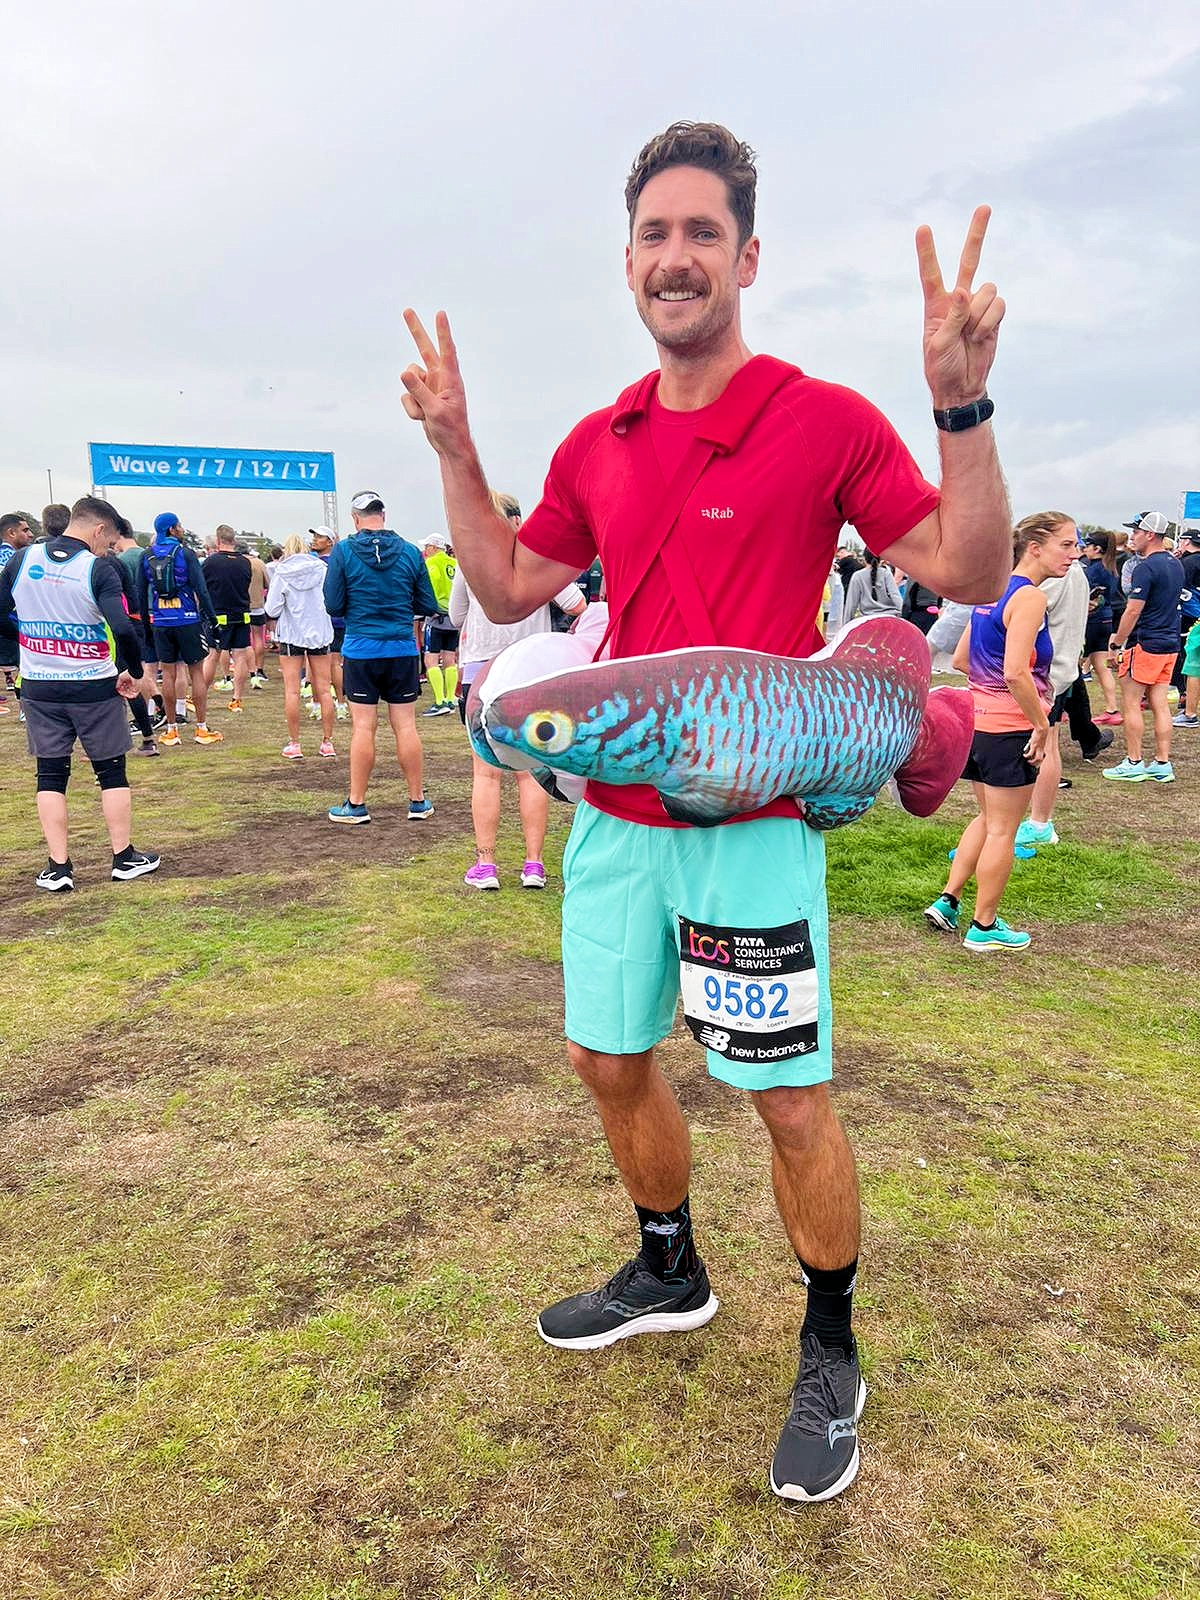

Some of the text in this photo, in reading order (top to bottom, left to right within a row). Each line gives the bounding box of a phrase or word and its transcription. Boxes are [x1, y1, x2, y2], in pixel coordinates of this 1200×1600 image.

[109, 455, 320, 479] Wave 2 / 7 / 12 / 17
[711, 507, 734, 519] Rab
[58, 642, 101, 658] LIVES
[688, 926, 731, 965] tcs
[733, 936, 765, 947] TATA
[734, 942, 805, 959] CONSULTANCY
[735, 958, 782, 969] SERVICES
[704, 975, 789, 1020] 9582
[731, 1046, 754, 1058] new
[758, 1041, 805, 1059] balance
